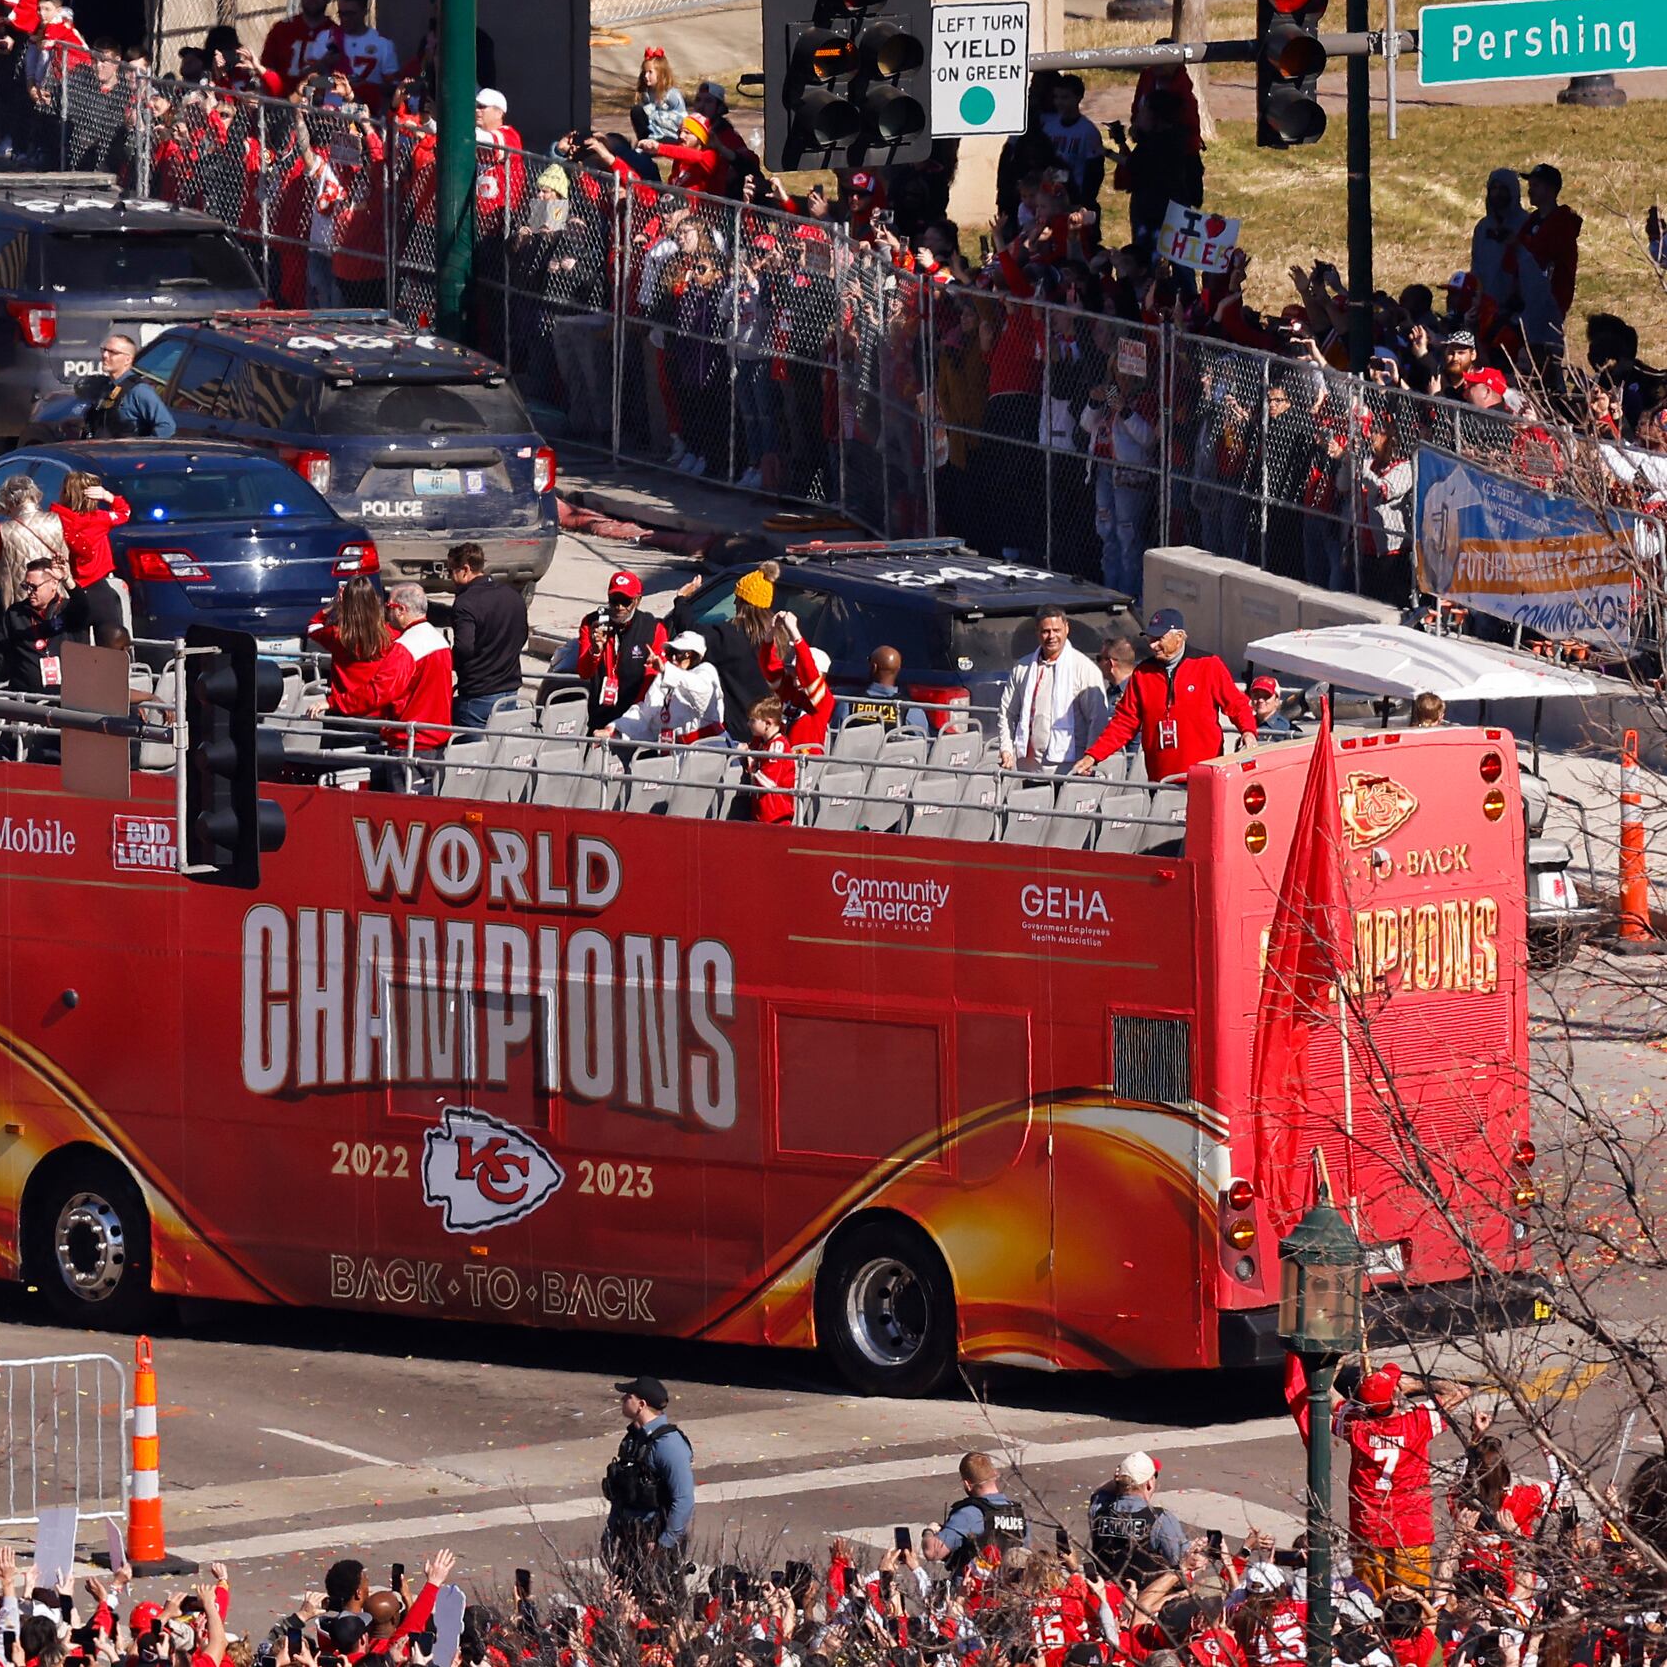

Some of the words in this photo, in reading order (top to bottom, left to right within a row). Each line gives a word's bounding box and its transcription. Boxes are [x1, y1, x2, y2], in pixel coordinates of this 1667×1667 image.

[938, 17, 976, 33] LEFT
[981, 14, 1024, 32] TURN
[944, 40, 1016, 60] YIELD
[1451, 14, 1636, 63] Pershing
[938, 67, 959, 83] ON
[965, 65, 1021, 82] GREEN
[1179, 209, 1203, 238] I
[64, 359, 108, 378] POLI
[361, 501, 424, 518] POLICE
[1513, 600, 1577, 634] COMING
[125, 820, 171, 845] BUD
[116, 842, 179, 868] LIGHT
[354, 816, 624, 909] WORLD
[1406, 842, 1472, 877] BACK
[831, 869, 950, 909] Community
[843, 920, 885, 932] CREDIT
[893, 923, 931, 934] UNION
[1021, 920, 1067, 934] Government
[1068, 923, 1111, 937] Employees
[1031, 932, 1057, 943] Health
[1058, 935, 1103, 947] Association
[242, 905, 736, 1130] CHAMPIONS
[330, 1142, 410, 1179] 2022
[577, 1159, 654, 1199] 2023
[331, 1253, 446, 1307] BACK
[543, 1269, 656, 1324] BACK
[1373, 1448, 1401, 1491] 7
[994, 1515, 1024, 1531] POLICE
[1100, 1518, 1145, 1540] POLICE
